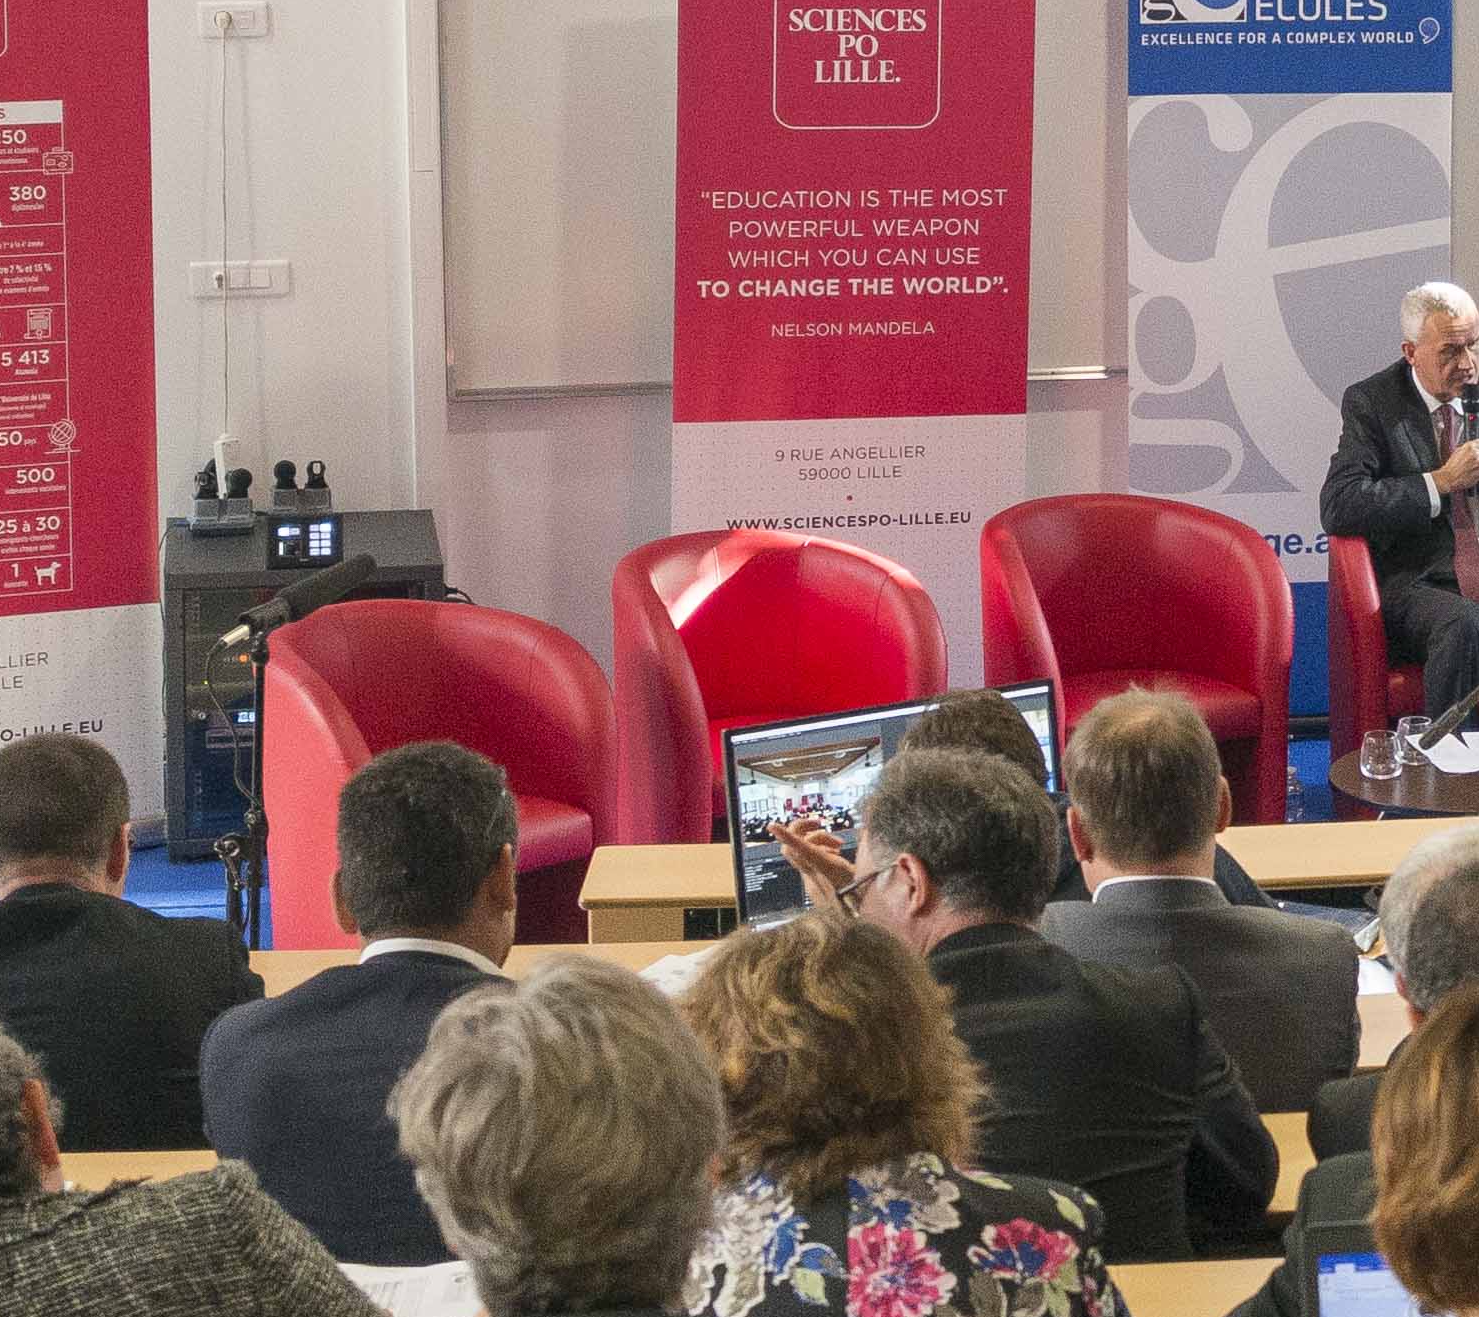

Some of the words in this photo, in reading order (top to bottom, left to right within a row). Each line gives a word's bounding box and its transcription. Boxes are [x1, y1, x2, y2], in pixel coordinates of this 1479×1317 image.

[788, 8, 927, 32] SCIENCES
[837, 34, 879, 58] PO
[1141, 33, 1232, 46] EXCELLENCE
[1238, 33, 1266, 45] FOR
[1271, 33, 1281, 44] A
[1286, 32, 1355, 45] COMPLEX
[1361, 32, 1414, 44] WORLD
[814, 60, 901, 84] LILLE.
[9, 185, 46, 202] 380
[860, 190, 880, 208] IS
[888, 189, 934, 207] THE
[942, 188, 1009, 206] MOST
[729, 219, 863, 239] POWERFUL
[872, 218, 981, 237] WEAPON
[728, 250, 809, 269] WHICH
[818, 249, 868, 267] YOU
[876, 248, 927, 266] CAN
[935, 247, 981, 265] USE
[697, 280, 730, 298] TO
[738, 279, 840, 297] CHANGE
[849, 277, 894, 296] THE
[772, 323, 842, 337] NELSON
[848, 321, 935, 336] MANDELA
[18, 349, 51, 365] 413
[775, 450, 785, 463] 9
[790, 449, 824, 462] RUE
[829, 446, 926, 461] ANGELLIER
[16, 468, 55, 484] 500
[799, 467, 851, 481] 59000
[857, 466, 903, 479] LILLE
[22, 521, 31, 533] à
[35, 516, 61, 532] 30
[726, 512, 971, 530] WWW.SCIENCESPO-LILLE.EU
[10, 563, 20, 578] 1
